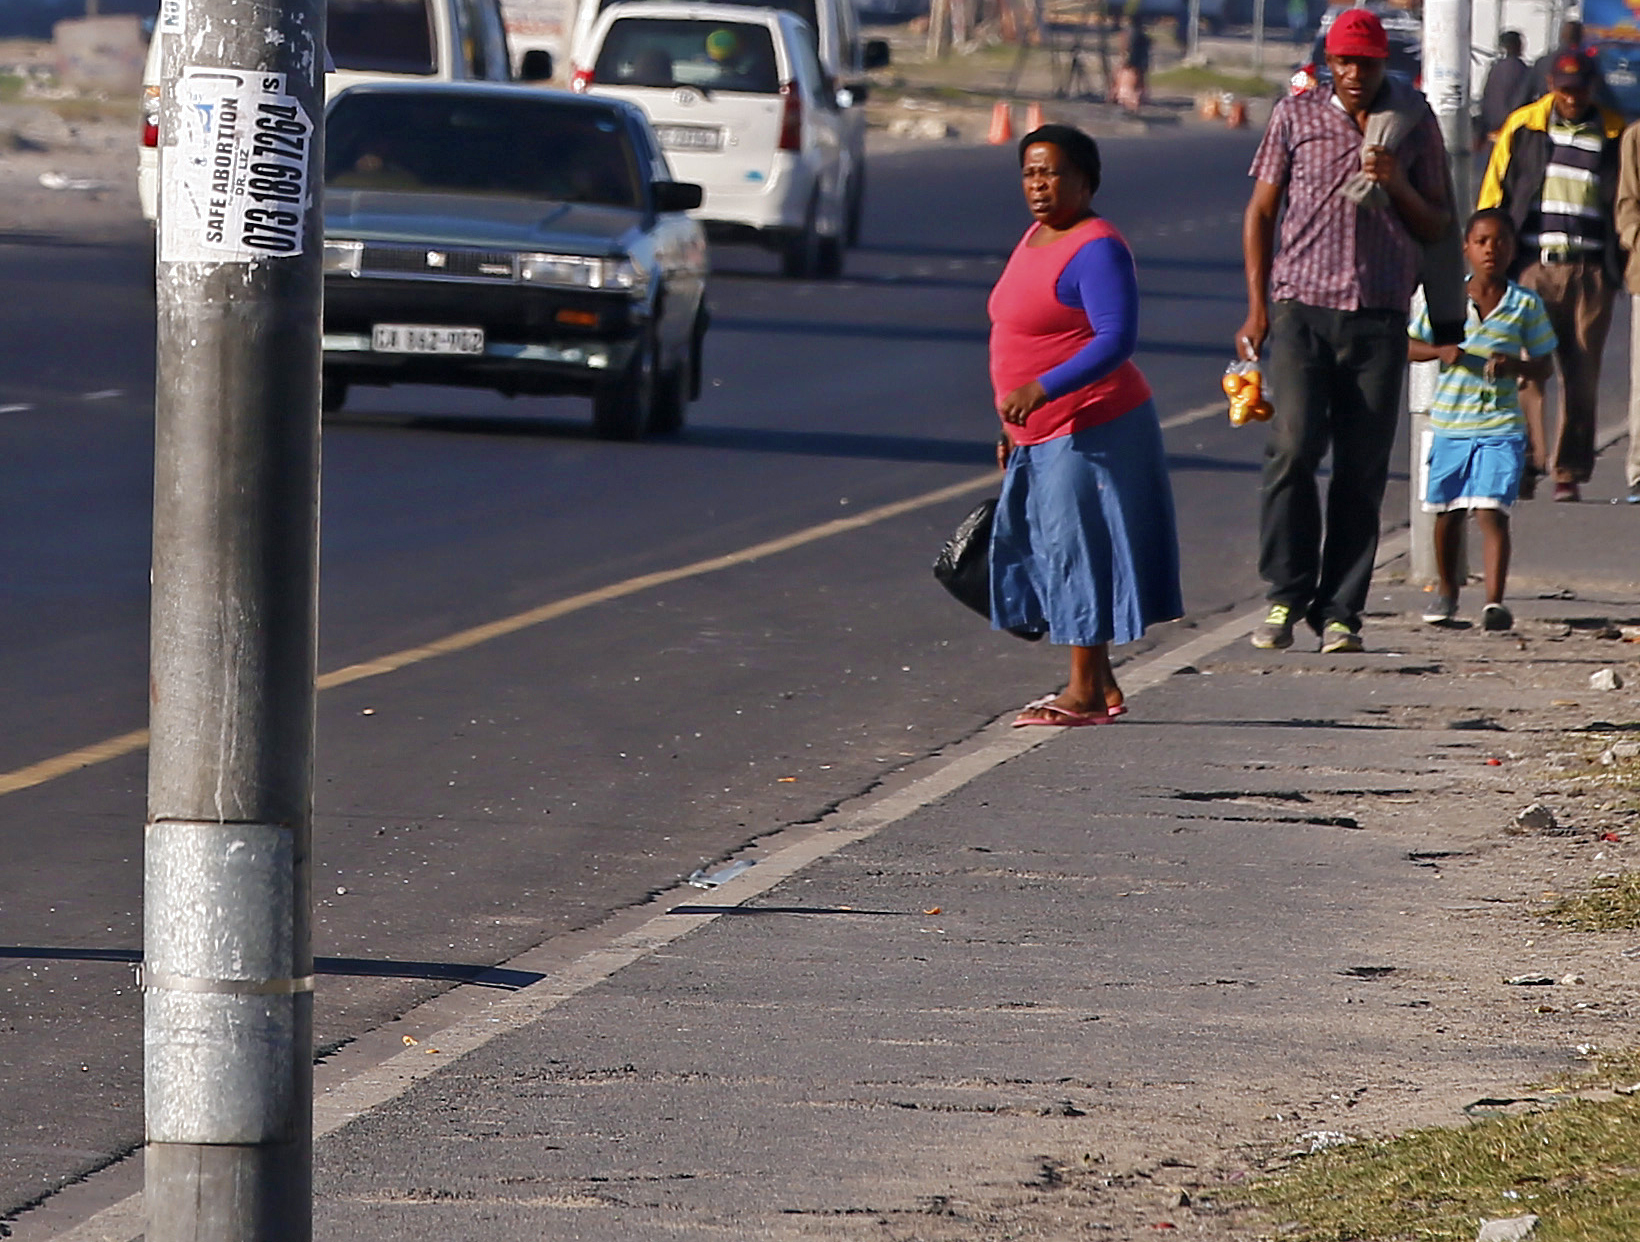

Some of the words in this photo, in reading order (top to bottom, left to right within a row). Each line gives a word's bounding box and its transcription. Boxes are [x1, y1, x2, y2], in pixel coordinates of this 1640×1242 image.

[213, 97, 240, 197] ABORTION
[253, 103, 308, 160] 7264
[238, 149, 249, 170] LIZ
[235, 174, 247, 196] DR.
[248, 163, 302, 207] 189
[206, 198, 226, 243] SAFE
[242, 208, 299, 252] 073
